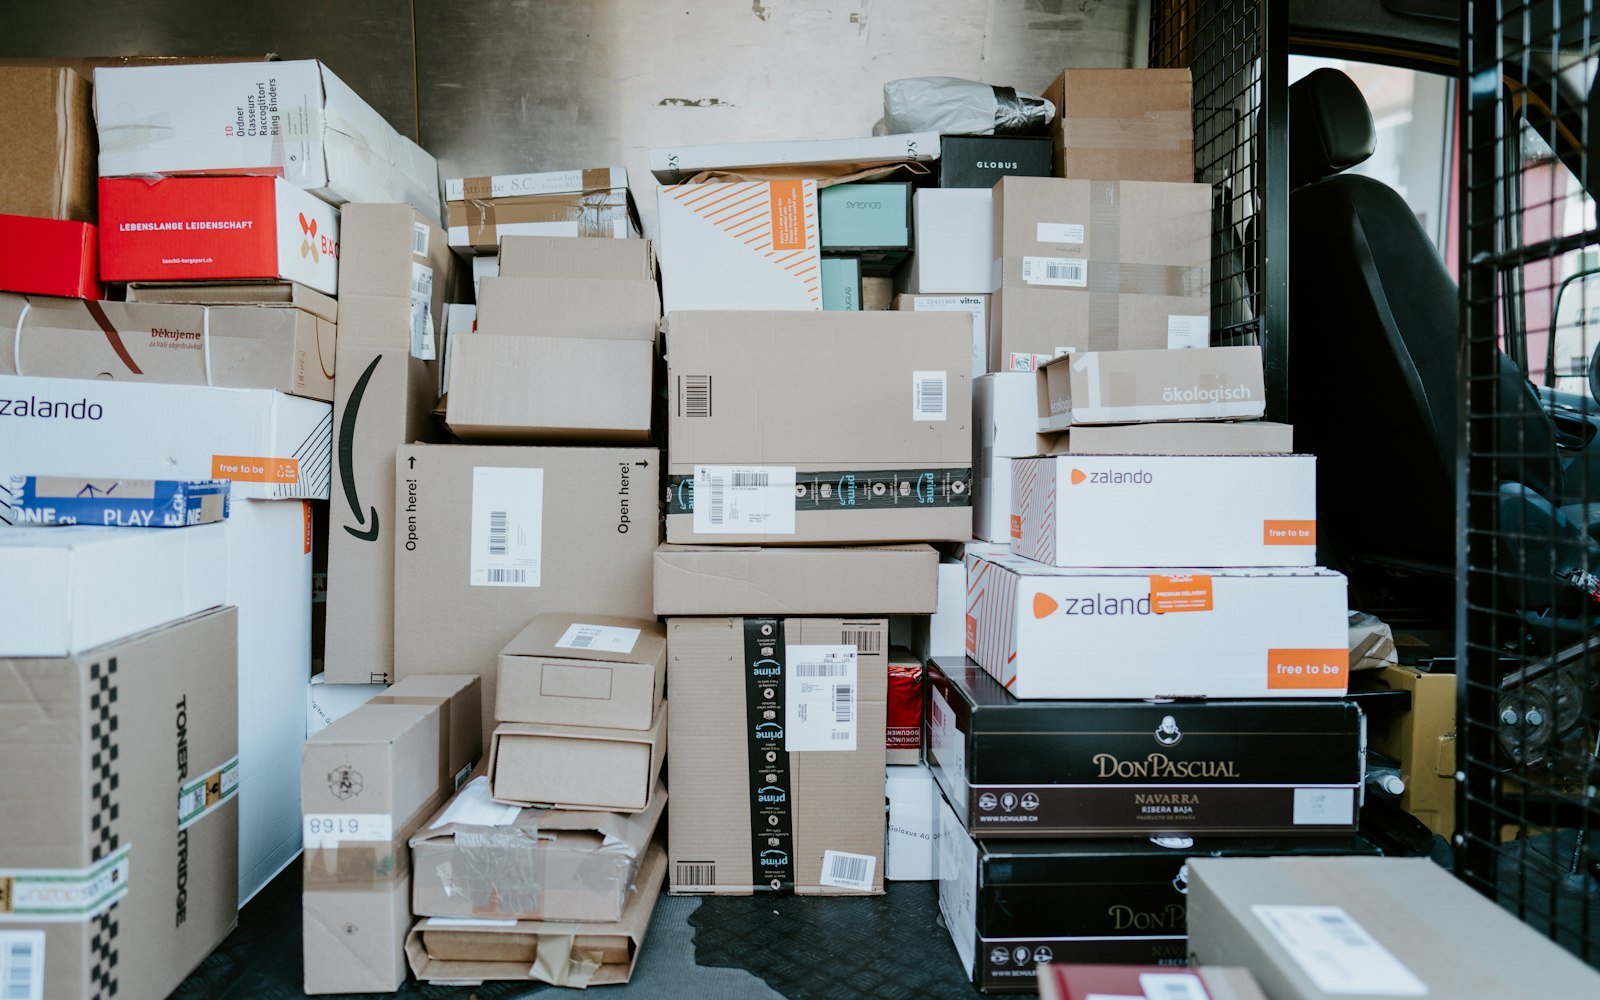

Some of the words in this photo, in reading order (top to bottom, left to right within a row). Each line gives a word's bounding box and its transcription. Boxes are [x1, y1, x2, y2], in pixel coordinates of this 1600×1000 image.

[268, 78, 278, 112] Binders
[248, 95, 256, 136] Classeurs
[256, 82, 268, 136] Raccoglitori
[236, 106, 245, 136] Ordner
[271, 115, 280, 136] Ring
[225, 125, 234, 136] 10
[976, 160, 1018, 170] GLOBUS
[846, 201, 882, 210] DOUGLAS
[120, 222, 183, 232] LEBENSLANGE
[186, 221, 254, 230] LEIDENSCHAFT
[151, 328, 202, 341] Děkujeme
[1162, 384, 1250, 402] ökologisch
[0, 396, 102, 420] zalando
[220, 463, 238, 472] free
[241, 464, 250, 473] to
[252, 466, 264, 474] be
[1090, 470, 1153, 484] zalando
[618, 462, 630, 494] here!
[406, 478, 417, 516] here!
[846, 474, 856, 506] prime
[925, 472, 934, 504] prime
[104, 508, 154, 527] PLAY
[618, 500, 631, 534] Open
[405, 518, 418, 552] Open
[1269, 528, 1286, 537] free
[1288, 528, 1298, 537] to
[1299, 528, 1310, 537] be
[1066, 592, 1164, 616] zaland
[753, 659, 780, 677] prime
[1276, 663, 1302, 674] free
[1306, 664, 1318, 674] to
[1322, 663, 1340, 674] be
[176, 694, 188, 782] TONER
[756, 729, 783, 740] prime
[758, 792, 786, 804] prime
[1135, 794, 1200, 804] NAVARRA
[1142, 806, 1172, 814] RIBERA
[1173, 806, 1193, 814] BAJA
[310, 818, 358, 834] 6168
[889, 825, 918, 837] Galaxus
[760, 856, 788, 867] prime
